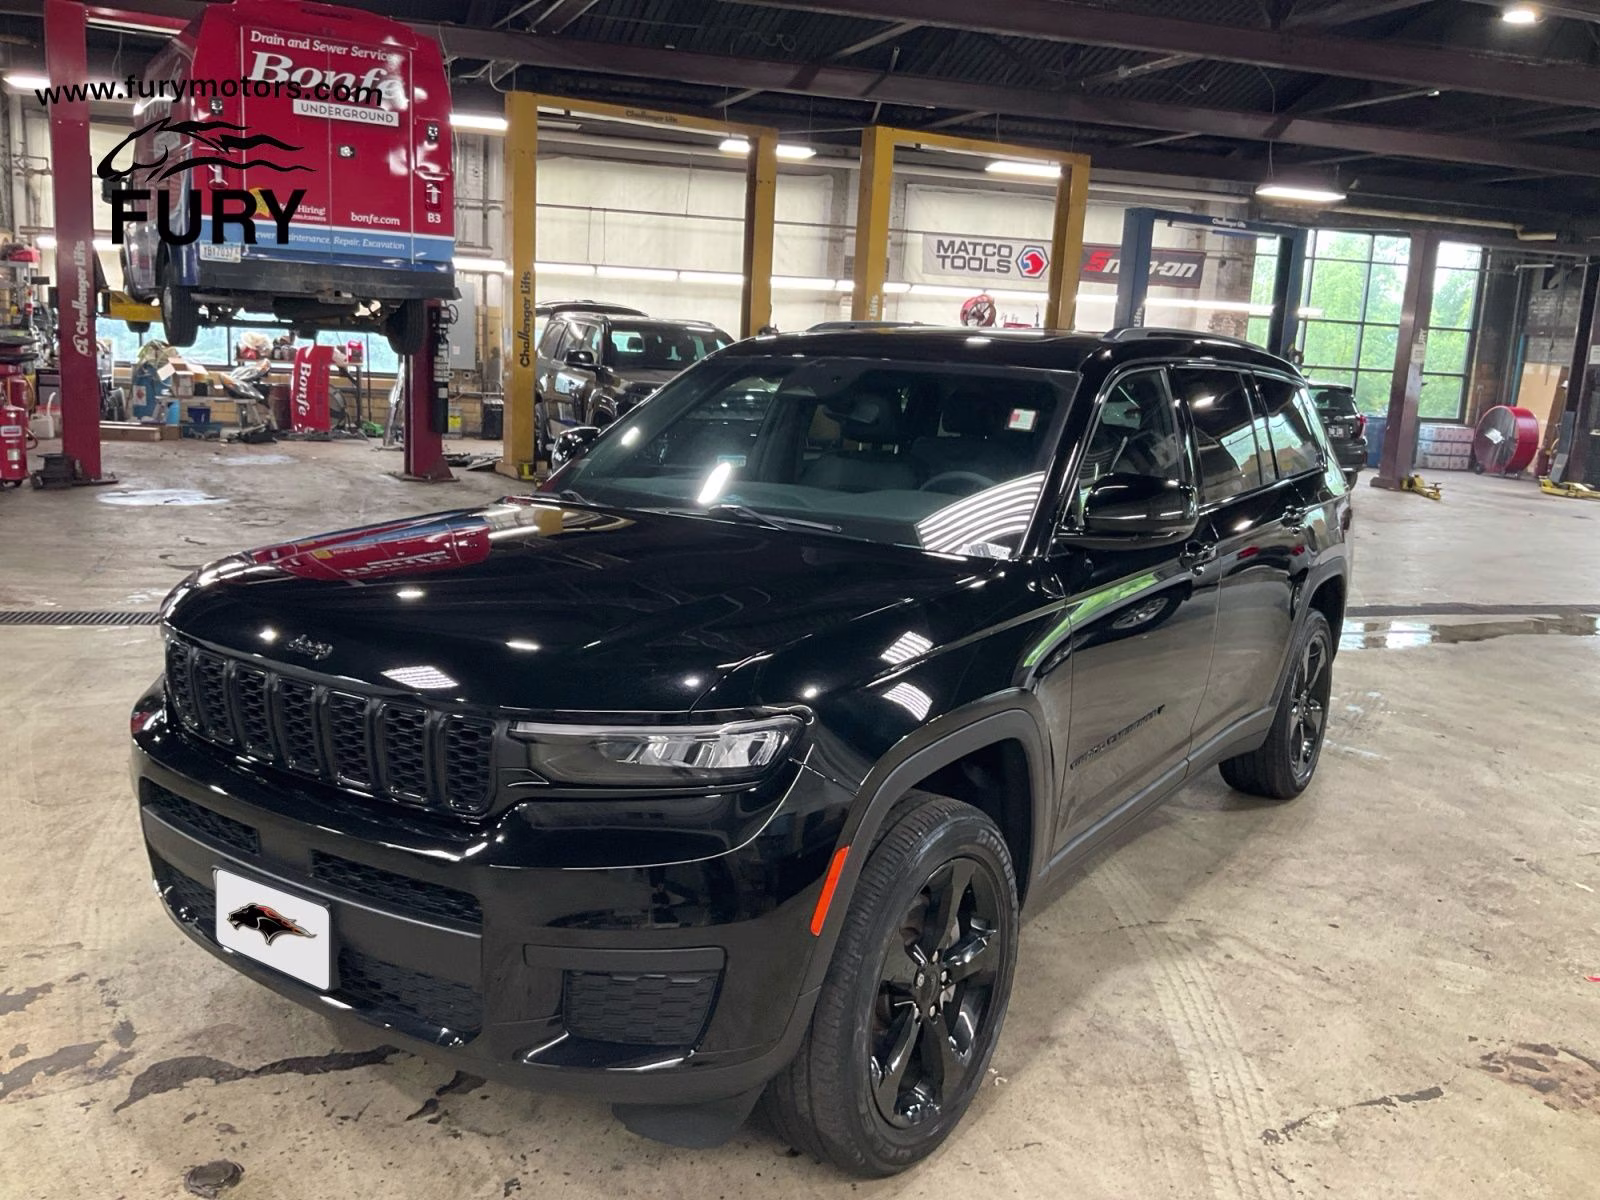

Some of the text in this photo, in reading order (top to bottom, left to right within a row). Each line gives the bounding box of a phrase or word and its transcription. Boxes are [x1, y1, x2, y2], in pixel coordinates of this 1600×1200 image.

[250, 30, 285, 47] Drain
[287, 37, 310, 50] and
[312, 40, 348, 56] Sewer
[300, 102, 394, 124] UNDERGROUND
[350, 211, 401, 226] bonfe.com
[427, 212, 441, 224] B3
[255, 231, 276, 240] ewer
[362, 238, 405, 250] Excavation
[936, 238, 1013, 259] MATCO
[936, 254, 1012, 273] TOOLS
[72, 266, 90, 335] Challenger
[517, 271, 533, 367] Challenger Lifts
[296, 361, 313, 416] Bonfe
